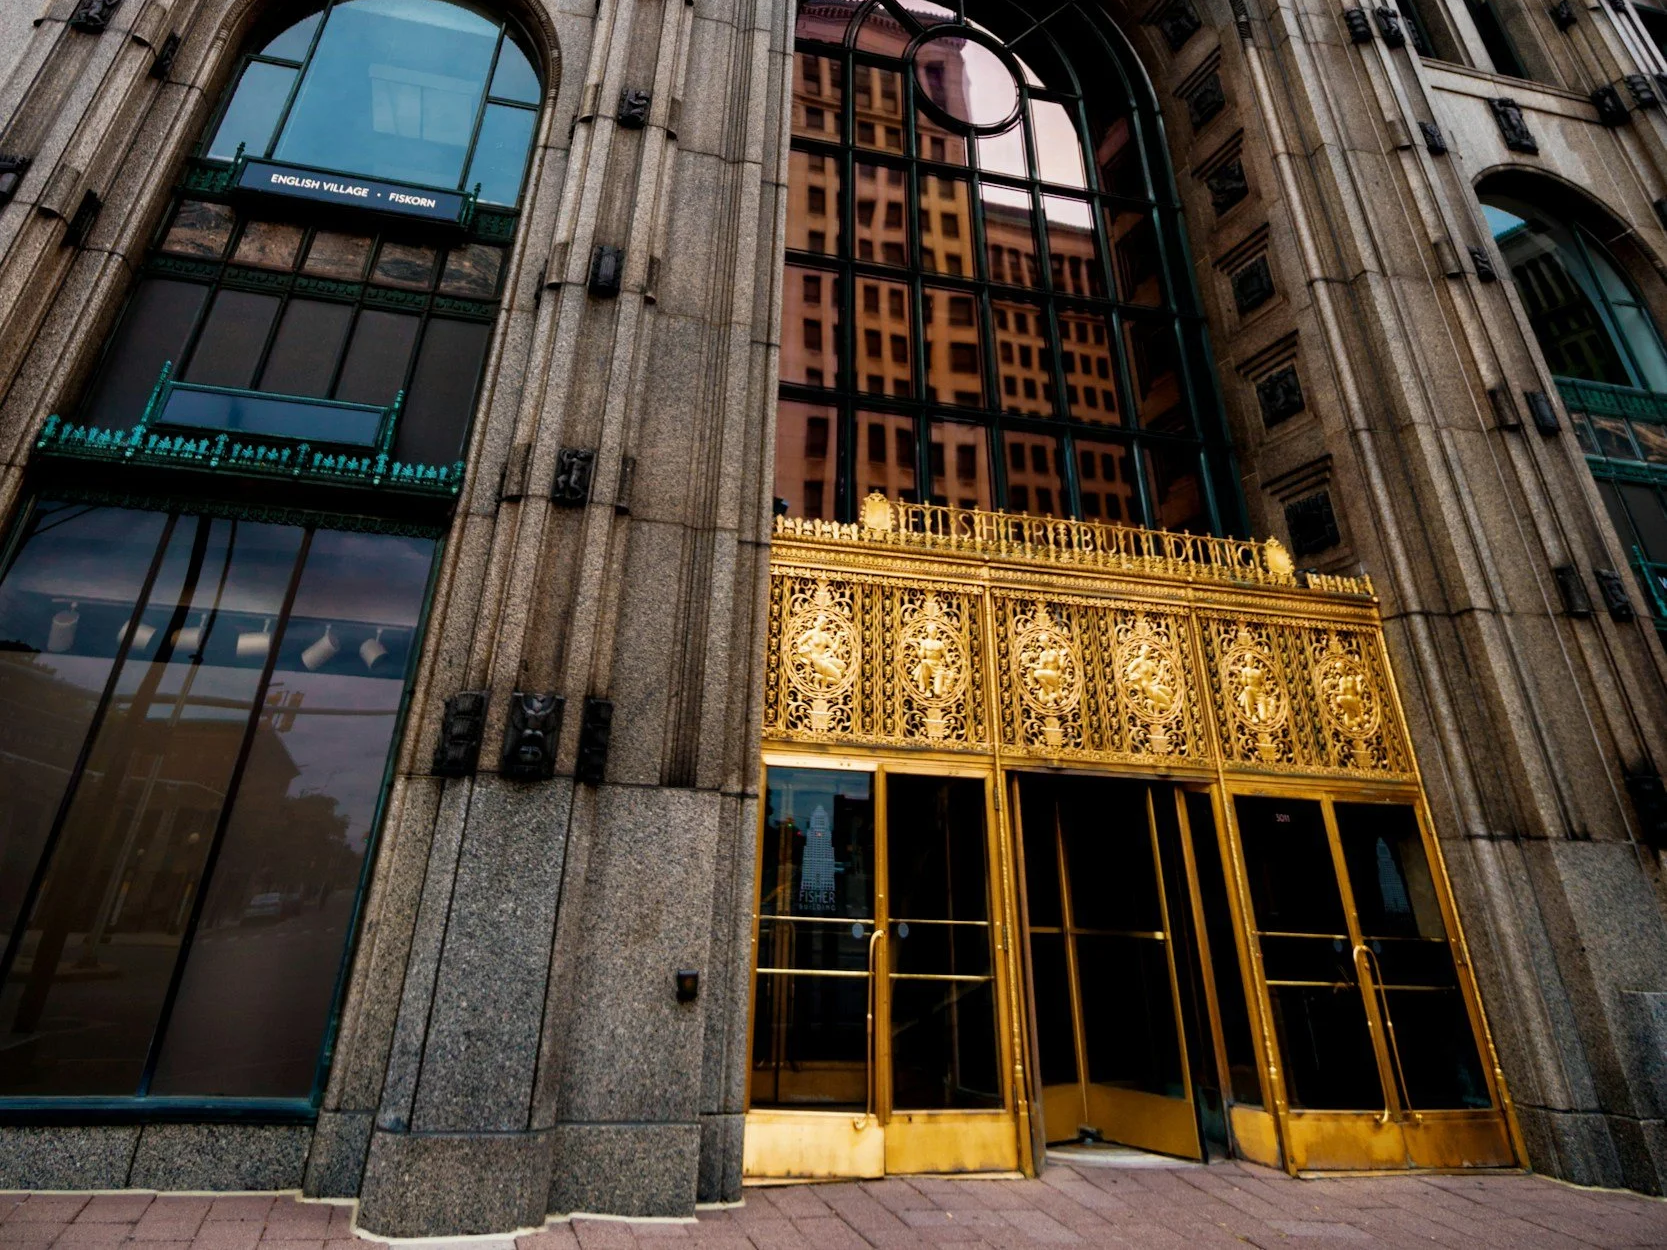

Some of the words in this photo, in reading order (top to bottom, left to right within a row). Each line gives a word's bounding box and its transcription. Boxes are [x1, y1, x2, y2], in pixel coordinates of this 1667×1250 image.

[270, 173, 320, 190] ENGLISH
[322, 182, 370, 198] VILLAGE
[388, 192, 436, 209] FISKORN
[908, 508, 1048, 547] FISHER
[1079, 525, 1255, 569] BUILDING
[799, 890, 836, 904] FISHER
